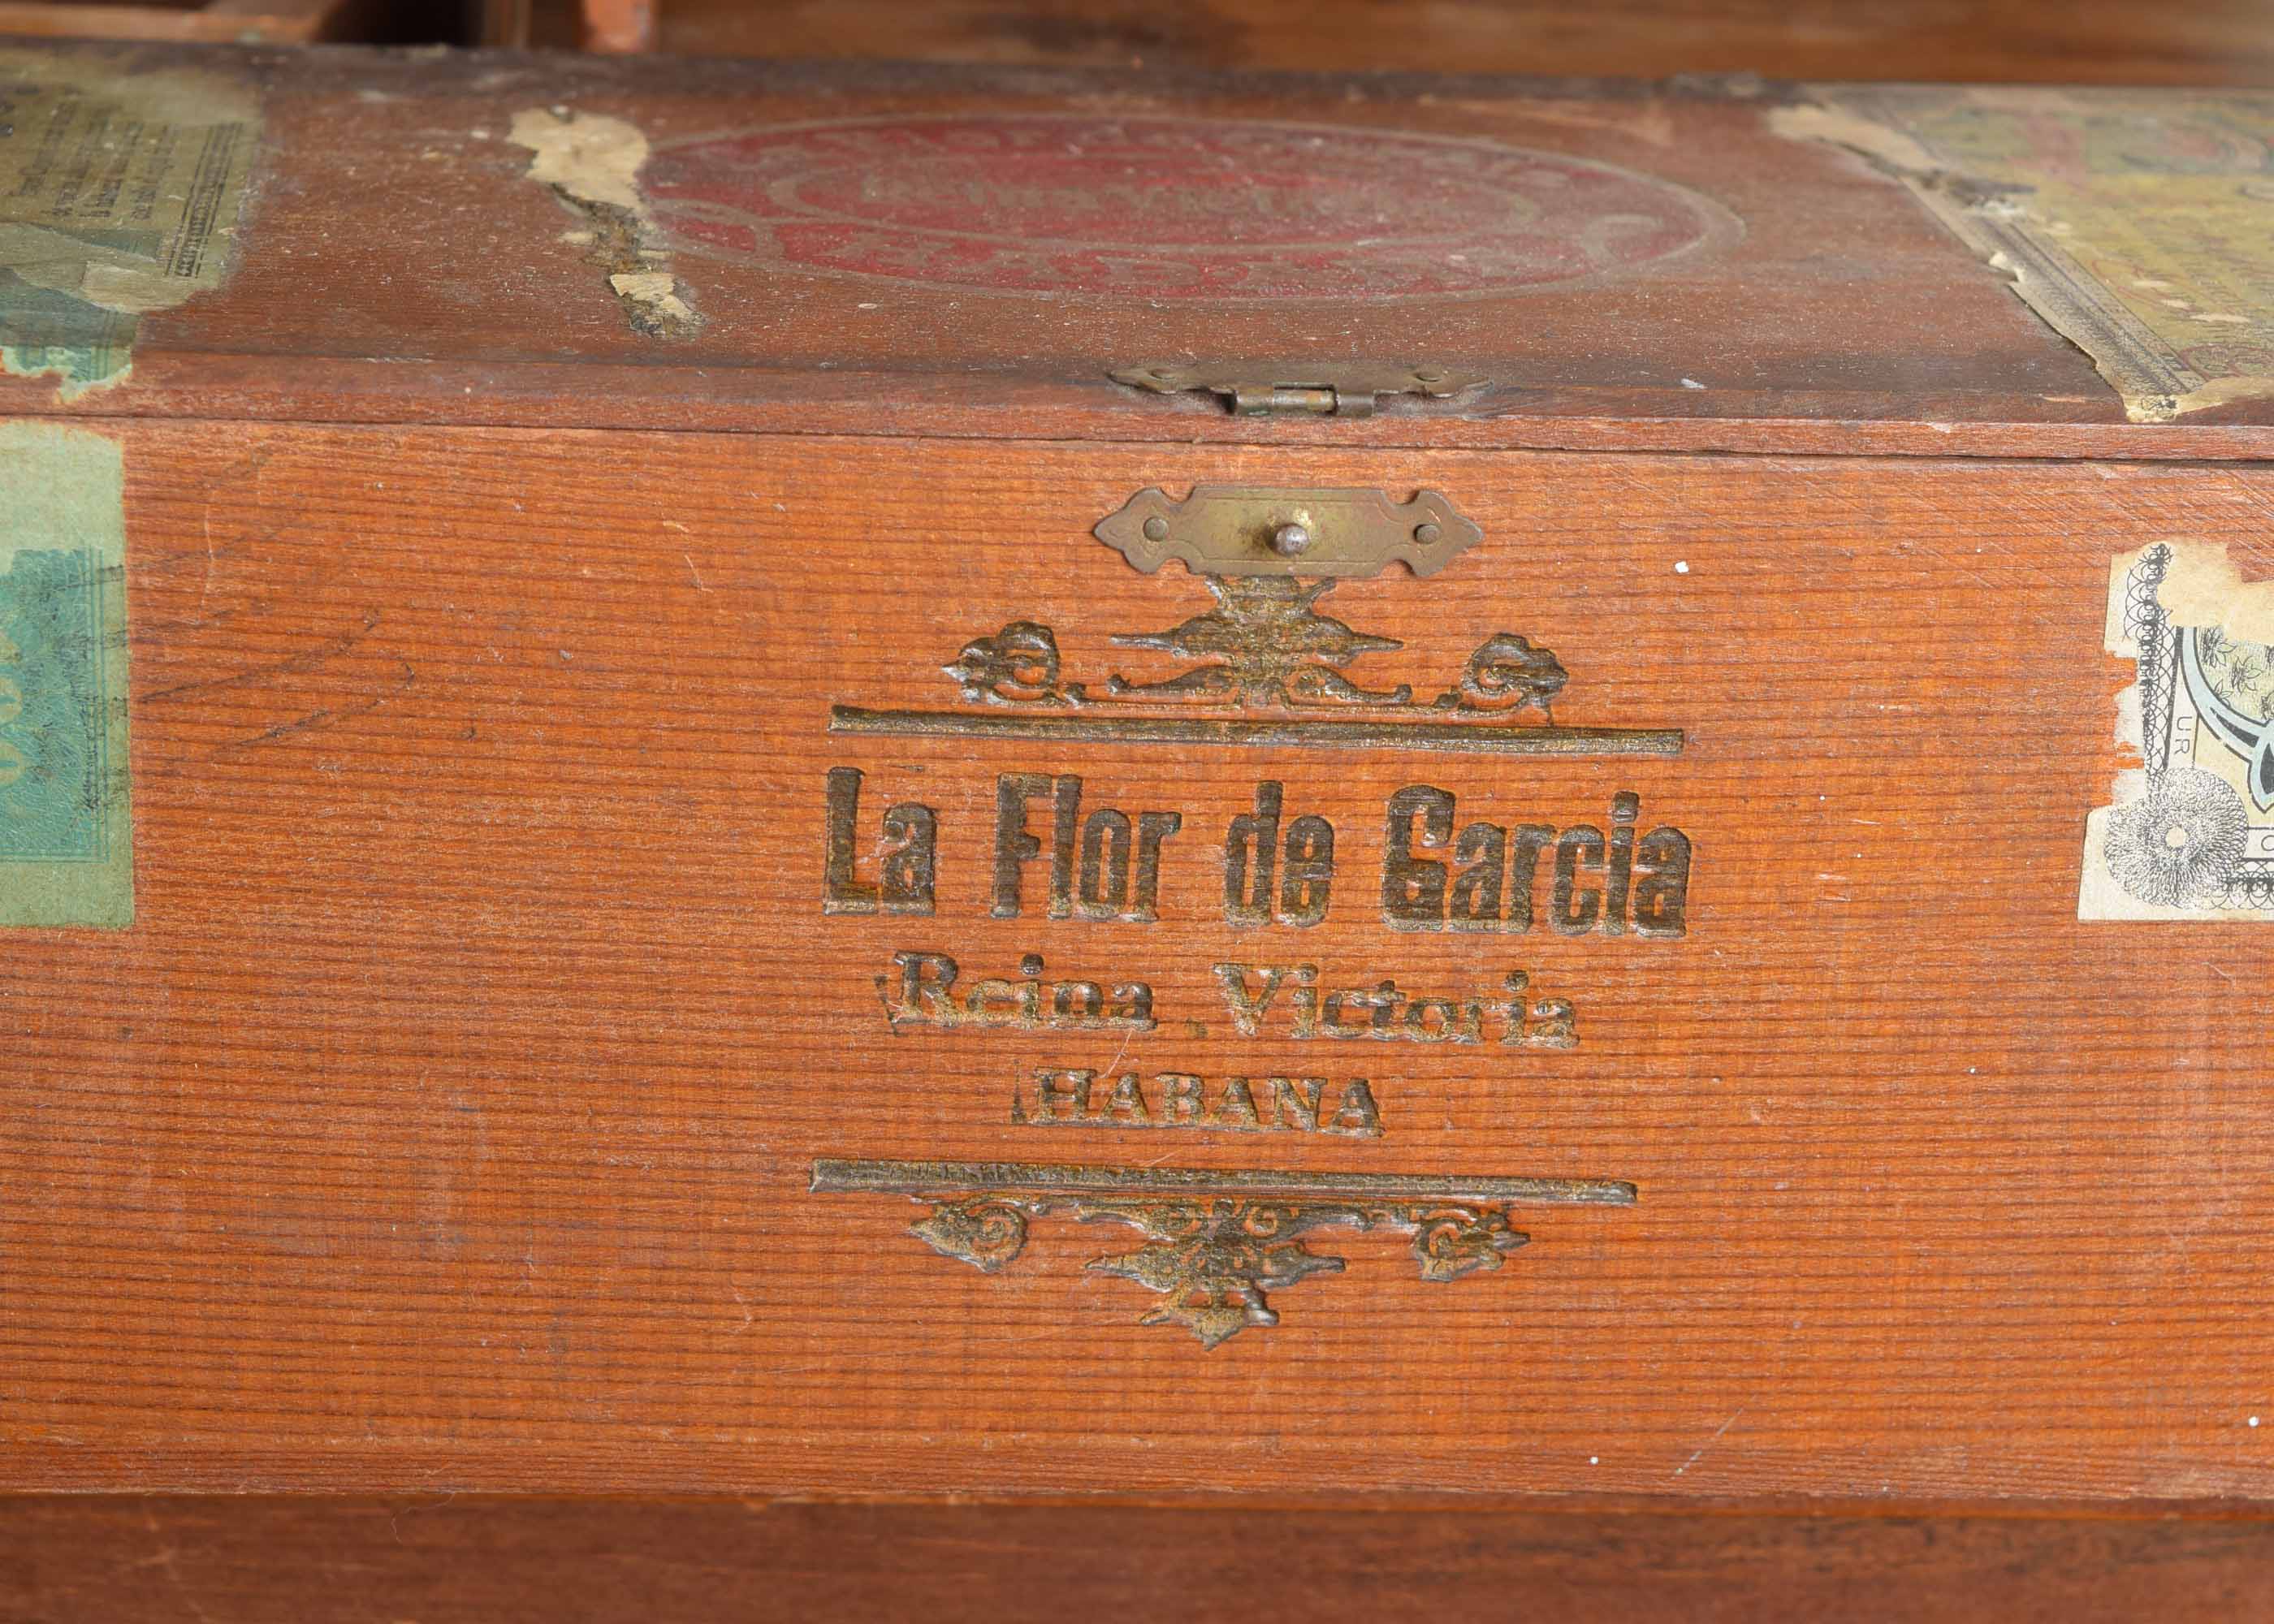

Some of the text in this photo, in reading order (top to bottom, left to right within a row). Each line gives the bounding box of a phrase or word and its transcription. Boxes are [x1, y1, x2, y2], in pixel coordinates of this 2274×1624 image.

[824, 766, 1692, 937] La Flor de Garcia
[893, 949, 1572, 1049] Reina Victoria
[1032, 1066, 1384, 1137] HABANA
